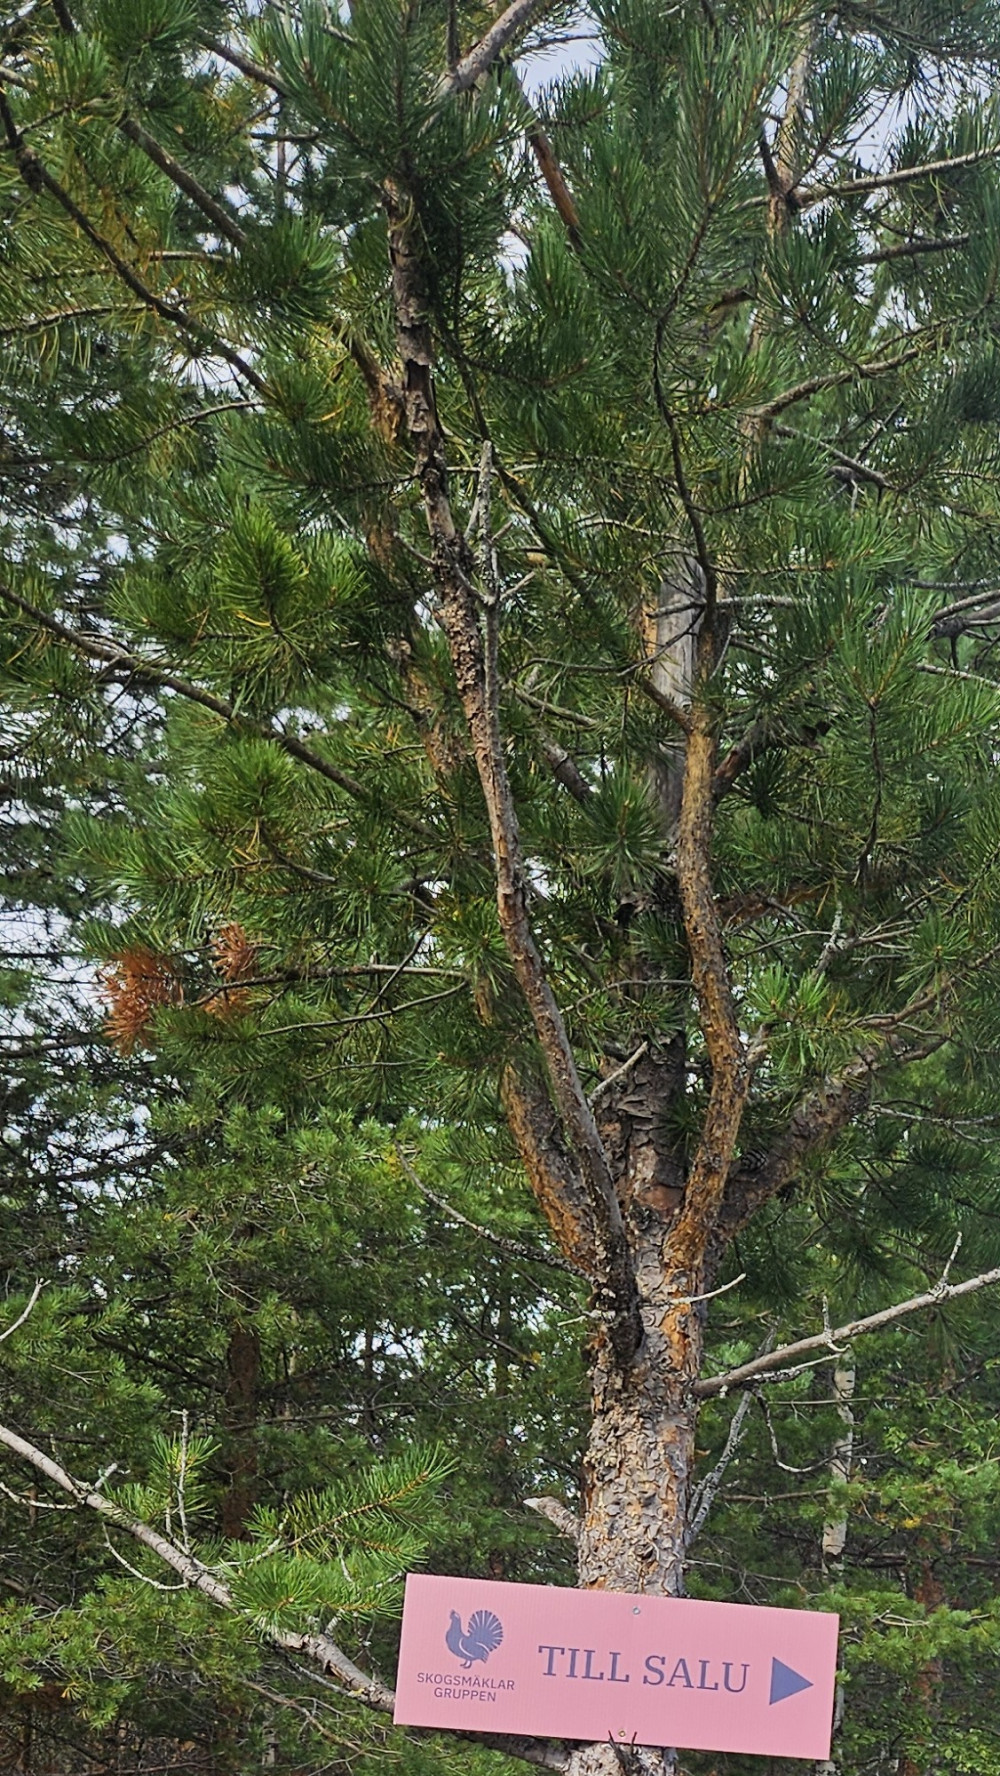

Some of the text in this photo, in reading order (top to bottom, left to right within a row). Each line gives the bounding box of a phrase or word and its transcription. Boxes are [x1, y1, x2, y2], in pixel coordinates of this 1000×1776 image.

[538, 1645, 750, 1693] TILL SALU
[417, 1672, 515, 1691] SKOGSMÄKLAR
[434, 1687, 497, 1702] GRUPPEN
